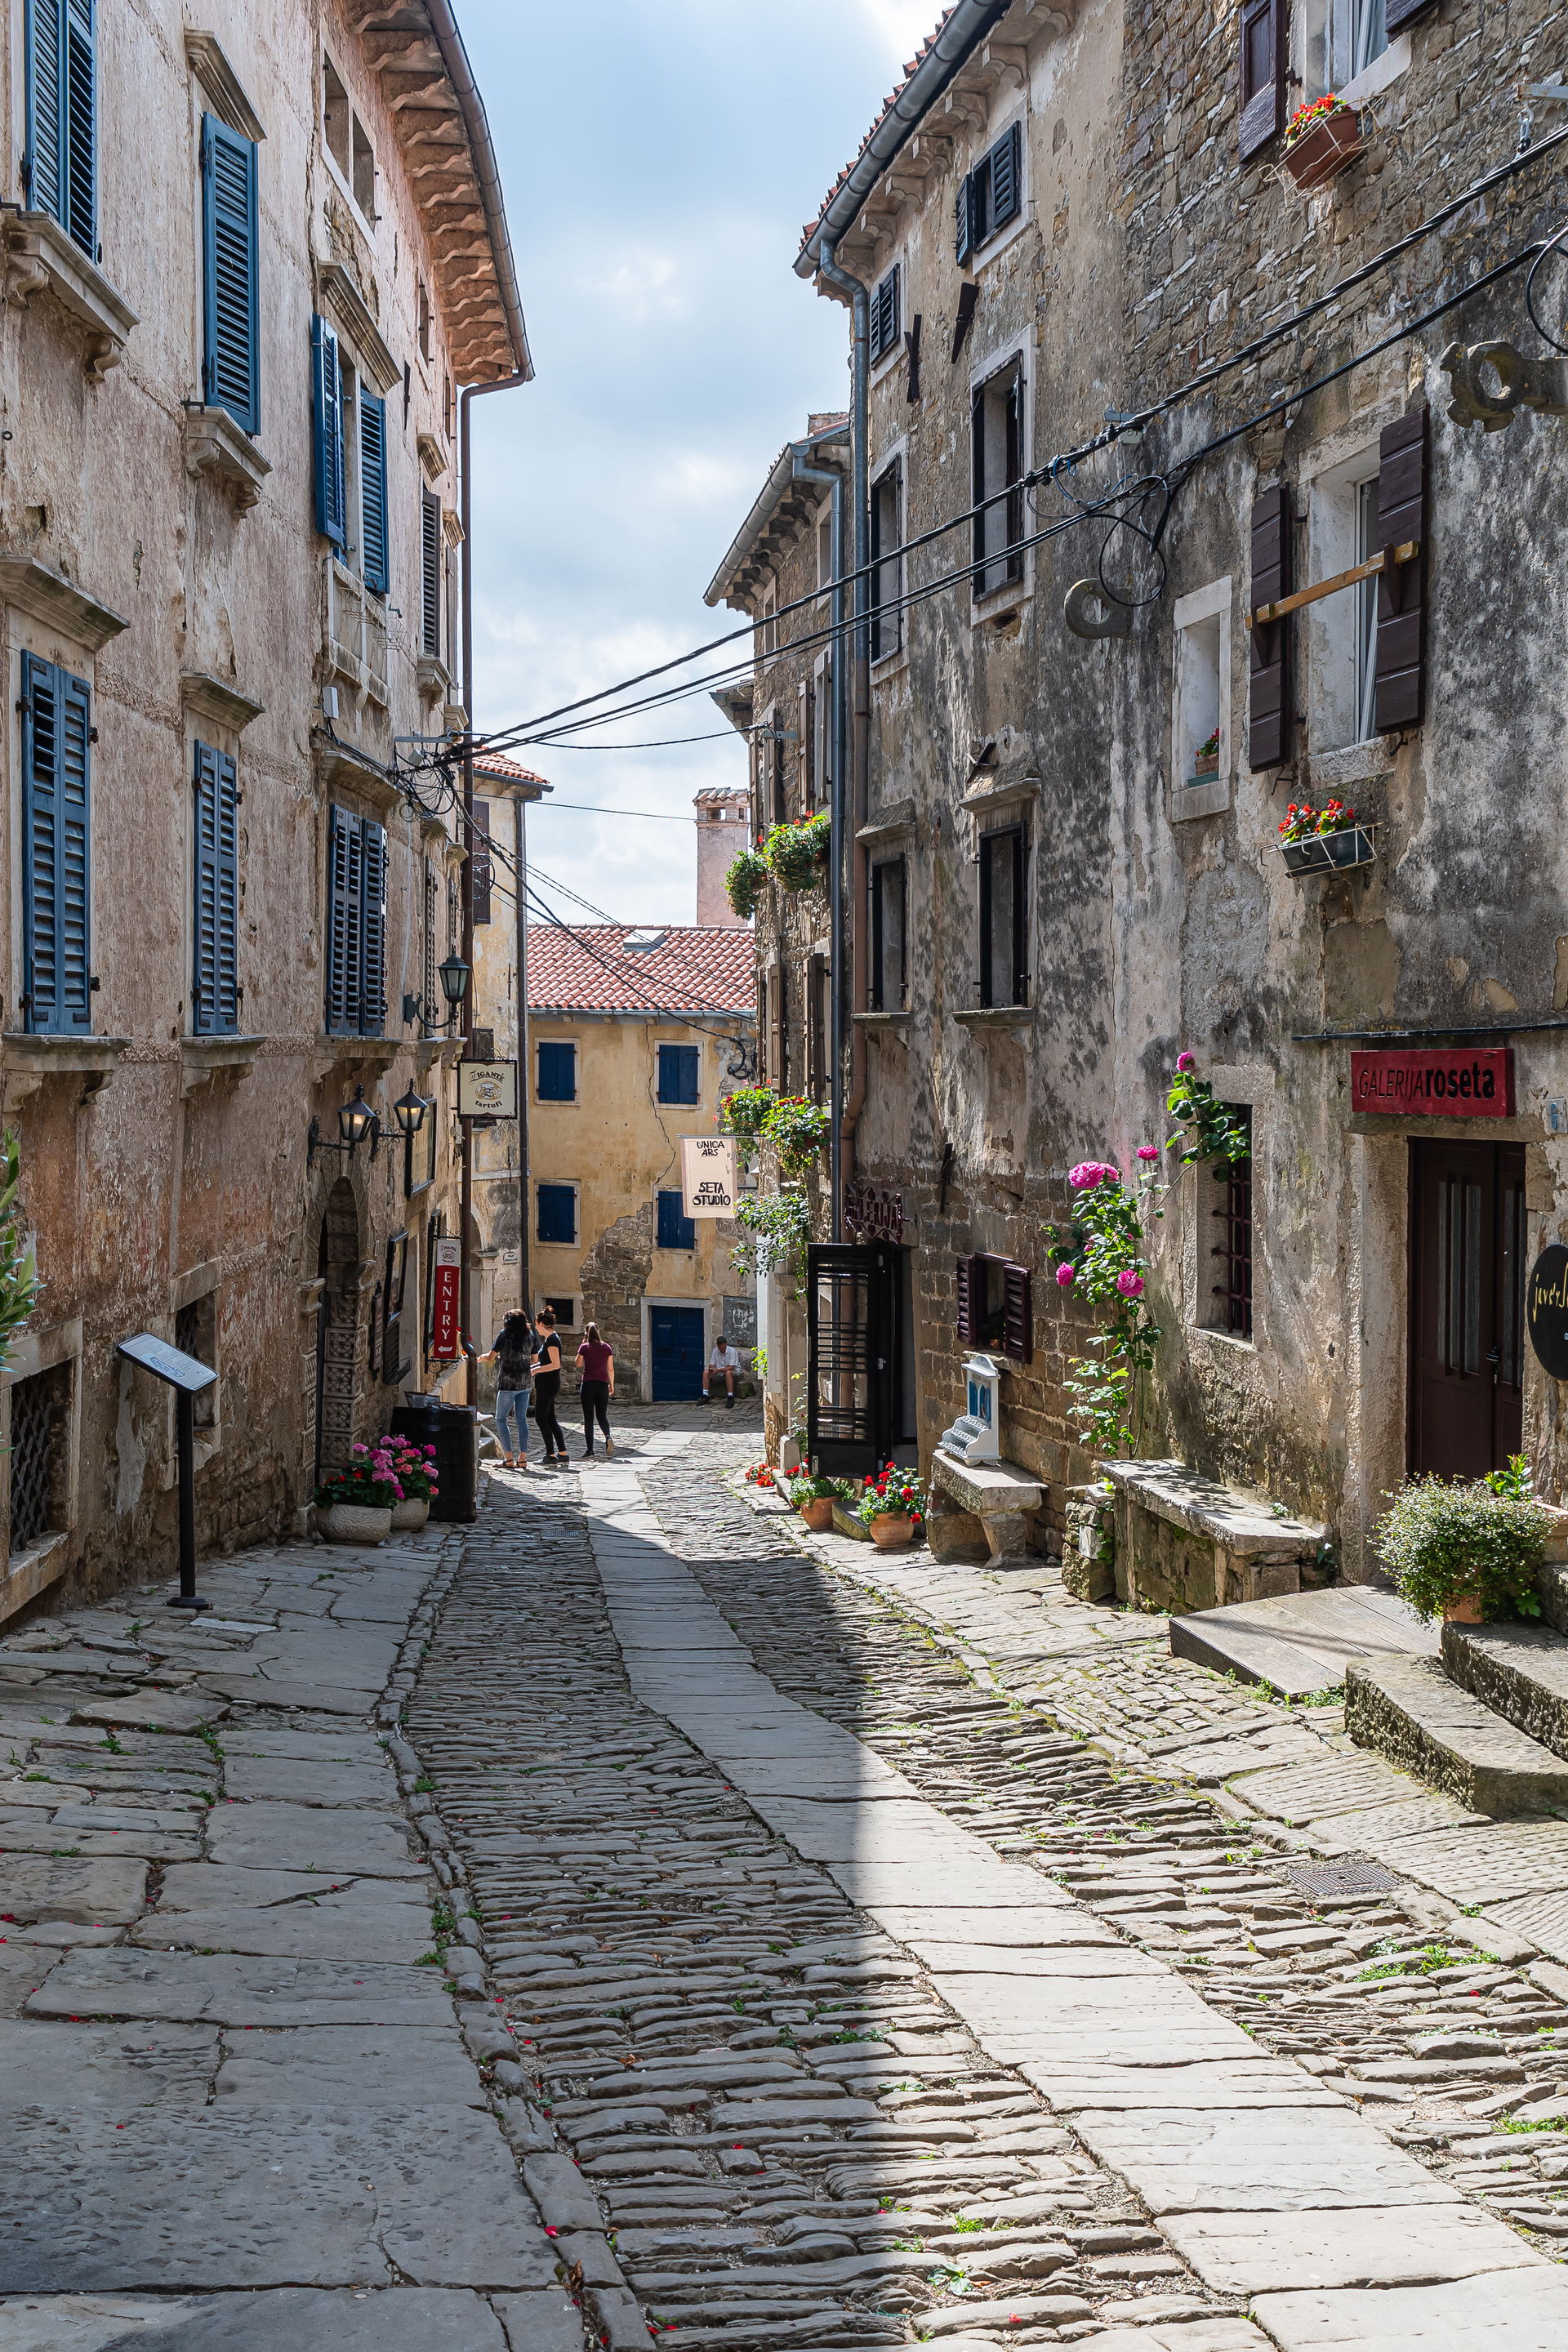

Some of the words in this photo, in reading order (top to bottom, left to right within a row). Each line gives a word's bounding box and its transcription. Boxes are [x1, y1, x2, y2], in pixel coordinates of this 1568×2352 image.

[469, 1069, 505, 1084] ZIGANTE
[474, 1100, 503, 1108] tartufi
[697, 1140, 725, 1149] UNICA
[702, 1148, 719, 1156] ARS
[698, 1182, 724, 1194] SETA
[693, 1194, 731, 1206] STUDIO
[442, 1272, 452, 1340] ENTRY
